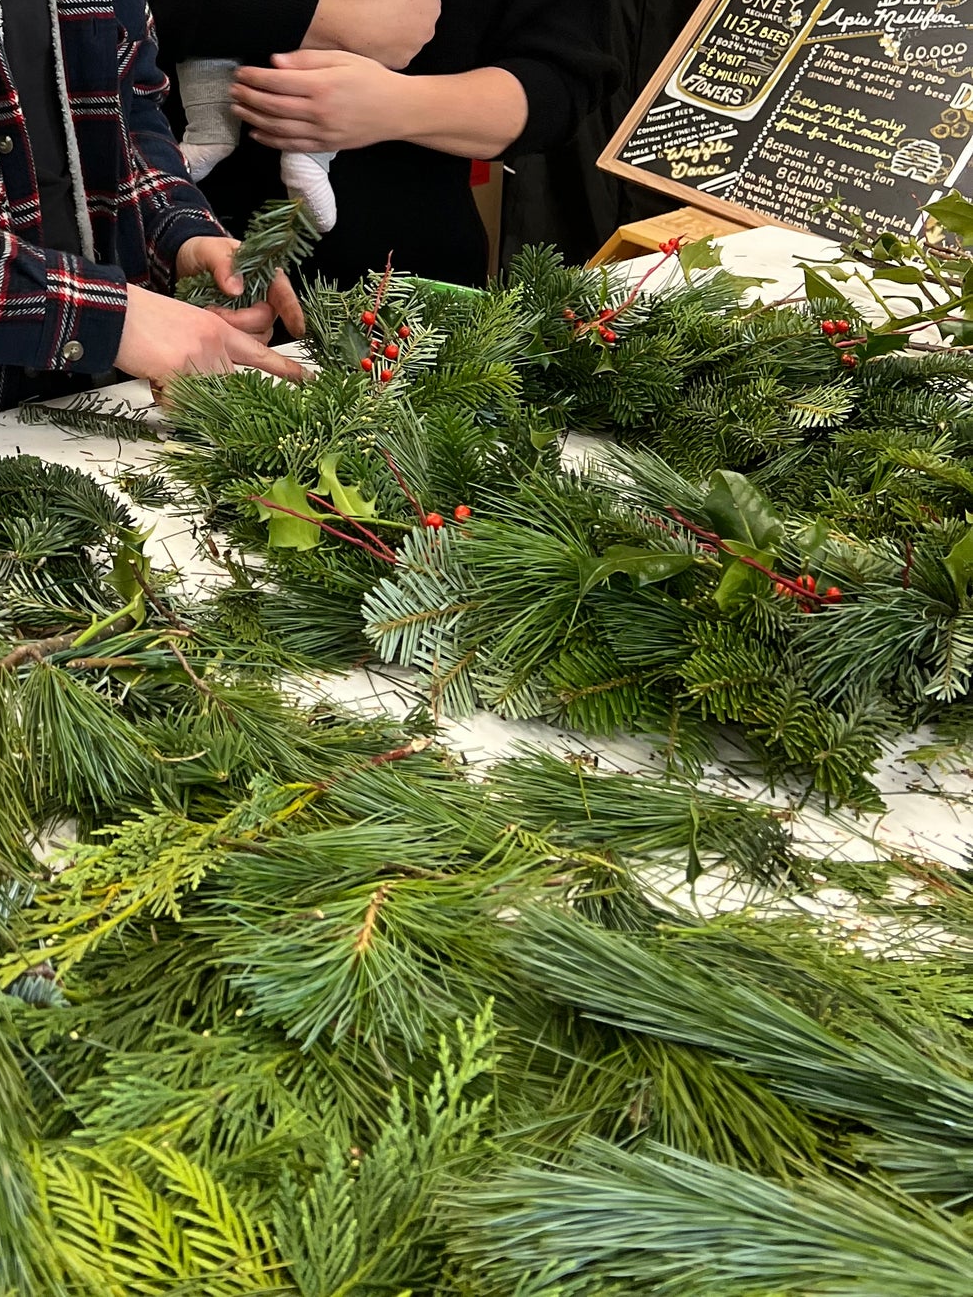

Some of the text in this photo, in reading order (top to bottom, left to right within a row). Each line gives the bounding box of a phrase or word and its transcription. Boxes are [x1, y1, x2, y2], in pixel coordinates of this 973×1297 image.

[723, 14, 790, 47] 1152 BEES
[745, 8, 783, 24] REQUIRES
[817, 7, 961, 32] Apis Mellifera
[730, 34, 740, 42] TO
[824, 44, 850, 61] There
[852, 55, 870, 67] are
[871, 59, 909, 76] around
[713, 68, 761, 87] MILLION
[807, 70, 843, 86] around
[845, 78, 862, 92] the
[813, 58, 861, 77] different
[861, 70, 904, 89] species
[908, 84, 923, 92] of
[925, 86, 952, 102] bees
[637, 113, 707, 136] COMMUNICATE THE
[646, 107, 694, 123] HONEY BEES
[781, 103, 897, 147] insect that make
[790, 90, 907, 137] Bees are the only
[623, 123, 734, 159] SOURCE BY PERFORMING THE
[628, 121, 720, 148] LOCATION OF THEIR FOOD
[774, 117, 893, 160] food for humans
[758, 148, 872, 191] that comes from the
[764, 136, 895, 187] Beeswax is a secretion
[738, 177, 775, 200] harden,
[778, 192, 808, 209] flake
[787, 170, 834, 194] GLANDS
[733, 187, 744, 198] to
[746, 191, 781, 210] become
[784, 207, 821, 225] pliable
[825, 218, 837, 230] to
[744, 171, 756, 181] on
[758, 174, 773, 187] the
[865, 209, 912, 232] droplets
